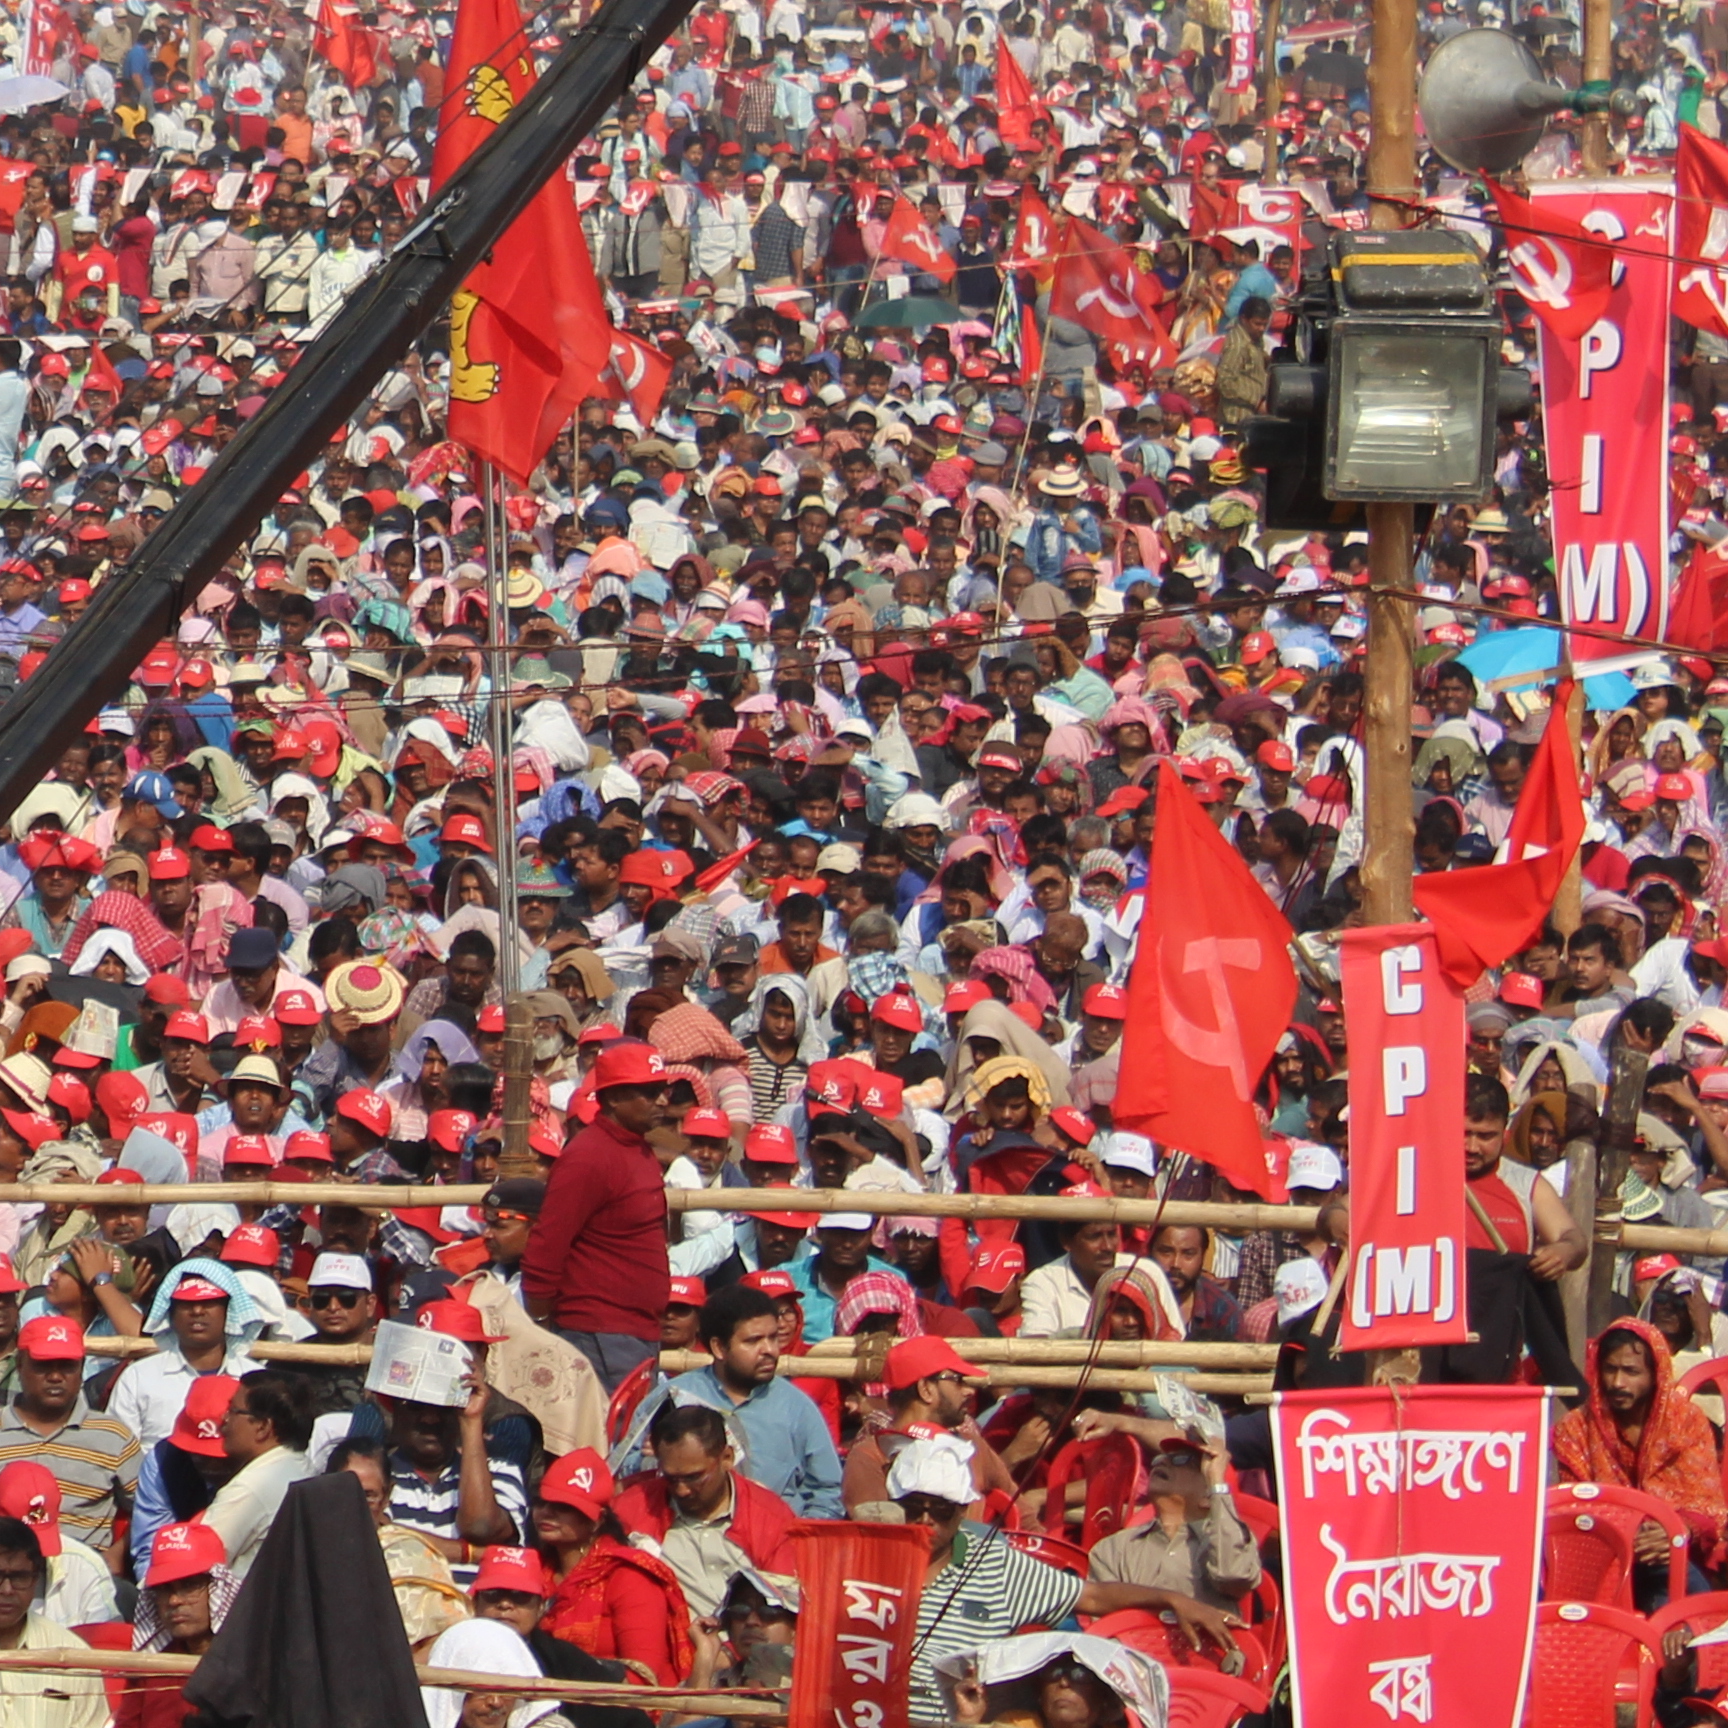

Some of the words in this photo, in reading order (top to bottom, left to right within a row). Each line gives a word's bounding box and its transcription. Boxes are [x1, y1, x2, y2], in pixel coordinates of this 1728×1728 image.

[1229, 10, 1252, 88] RSP
[1351, 945, 1455, 1328] CPI(M)
[1319, 1522, 1501, 1625] নৈরাজ্য
[1369, 1653, 1432, 1723] বন্ধ
